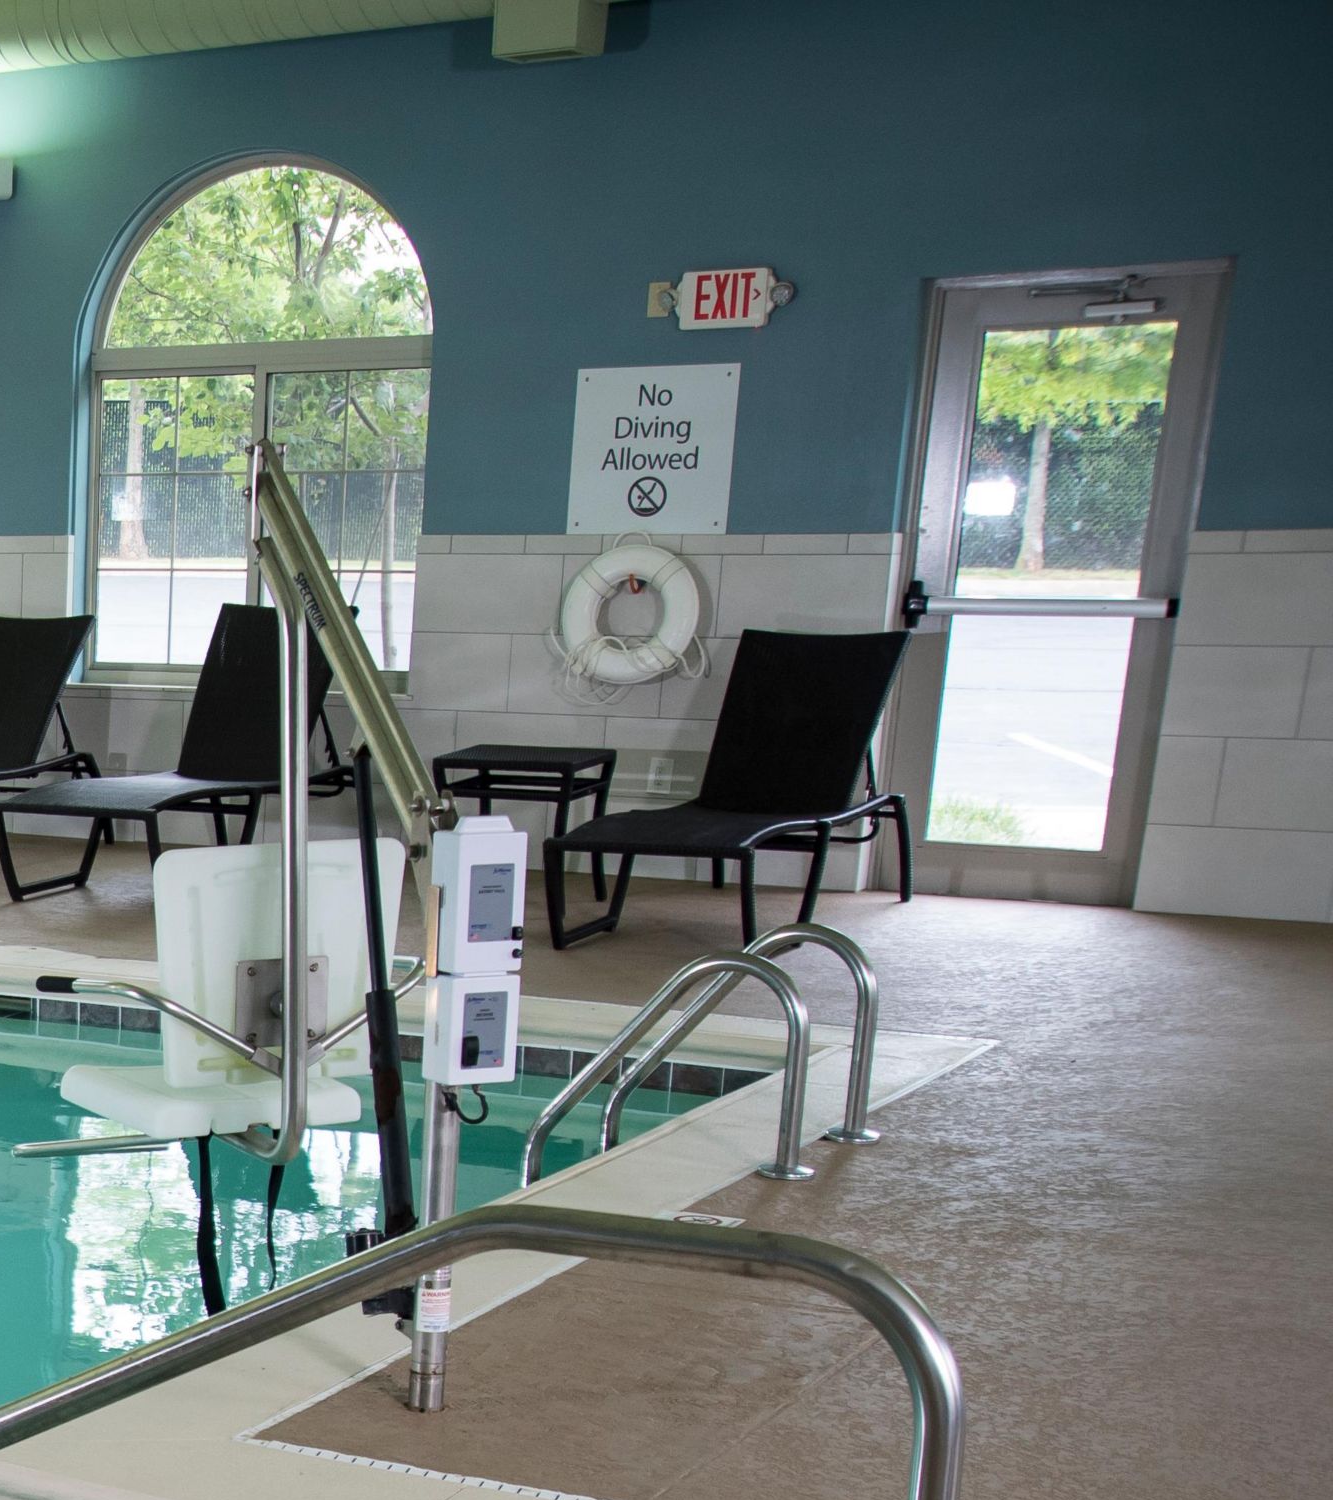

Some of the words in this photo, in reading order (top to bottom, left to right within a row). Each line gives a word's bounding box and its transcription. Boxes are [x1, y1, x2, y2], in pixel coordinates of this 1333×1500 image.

[694, 272, 756, 321] EXIT
[638, 384, 673, 407] No
[614, 416, 692, 444] Diving
[601, 446, 700, 471] Allowed
[294, 572, 326, 631] SPECTRUM
